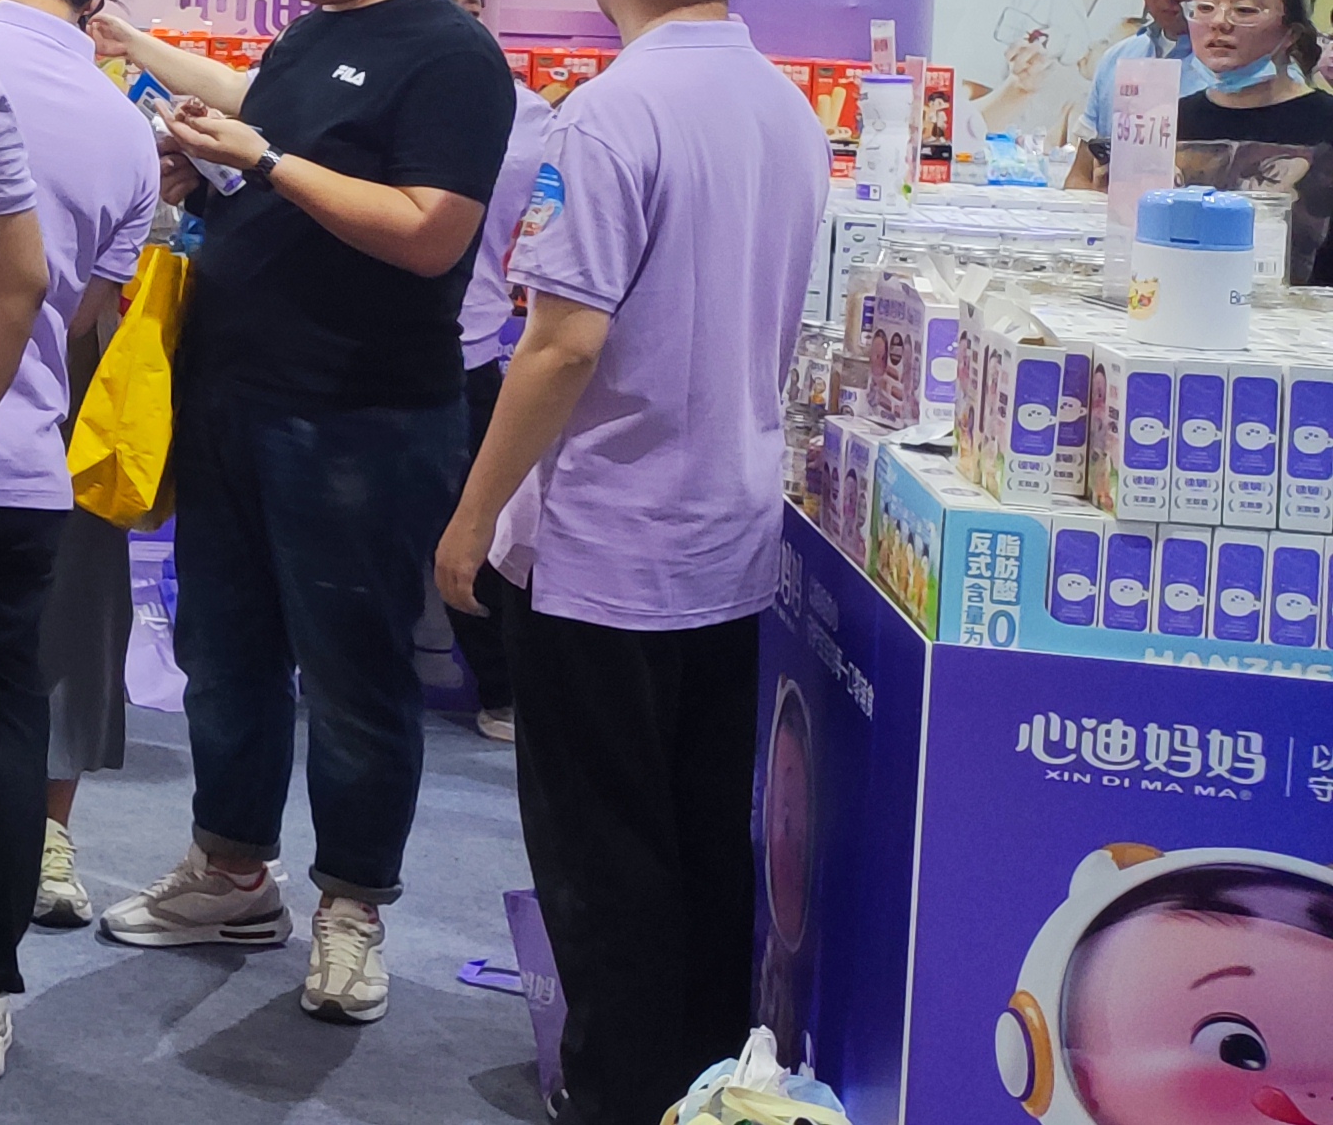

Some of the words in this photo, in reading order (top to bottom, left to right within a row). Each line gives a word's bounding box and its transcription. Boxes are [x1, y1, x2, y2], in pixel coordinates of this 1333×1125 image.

[332, 64, 366, 87] FILA
[993, 530, 1021, 606] 脂肪酸
[1015, 711, 1267, 786] 心迪妈妈
[1044, 768, 1085, 785] XIN
[1102, 773, 1131, 789] DI
[1140, 778, 1184, 795] MA
